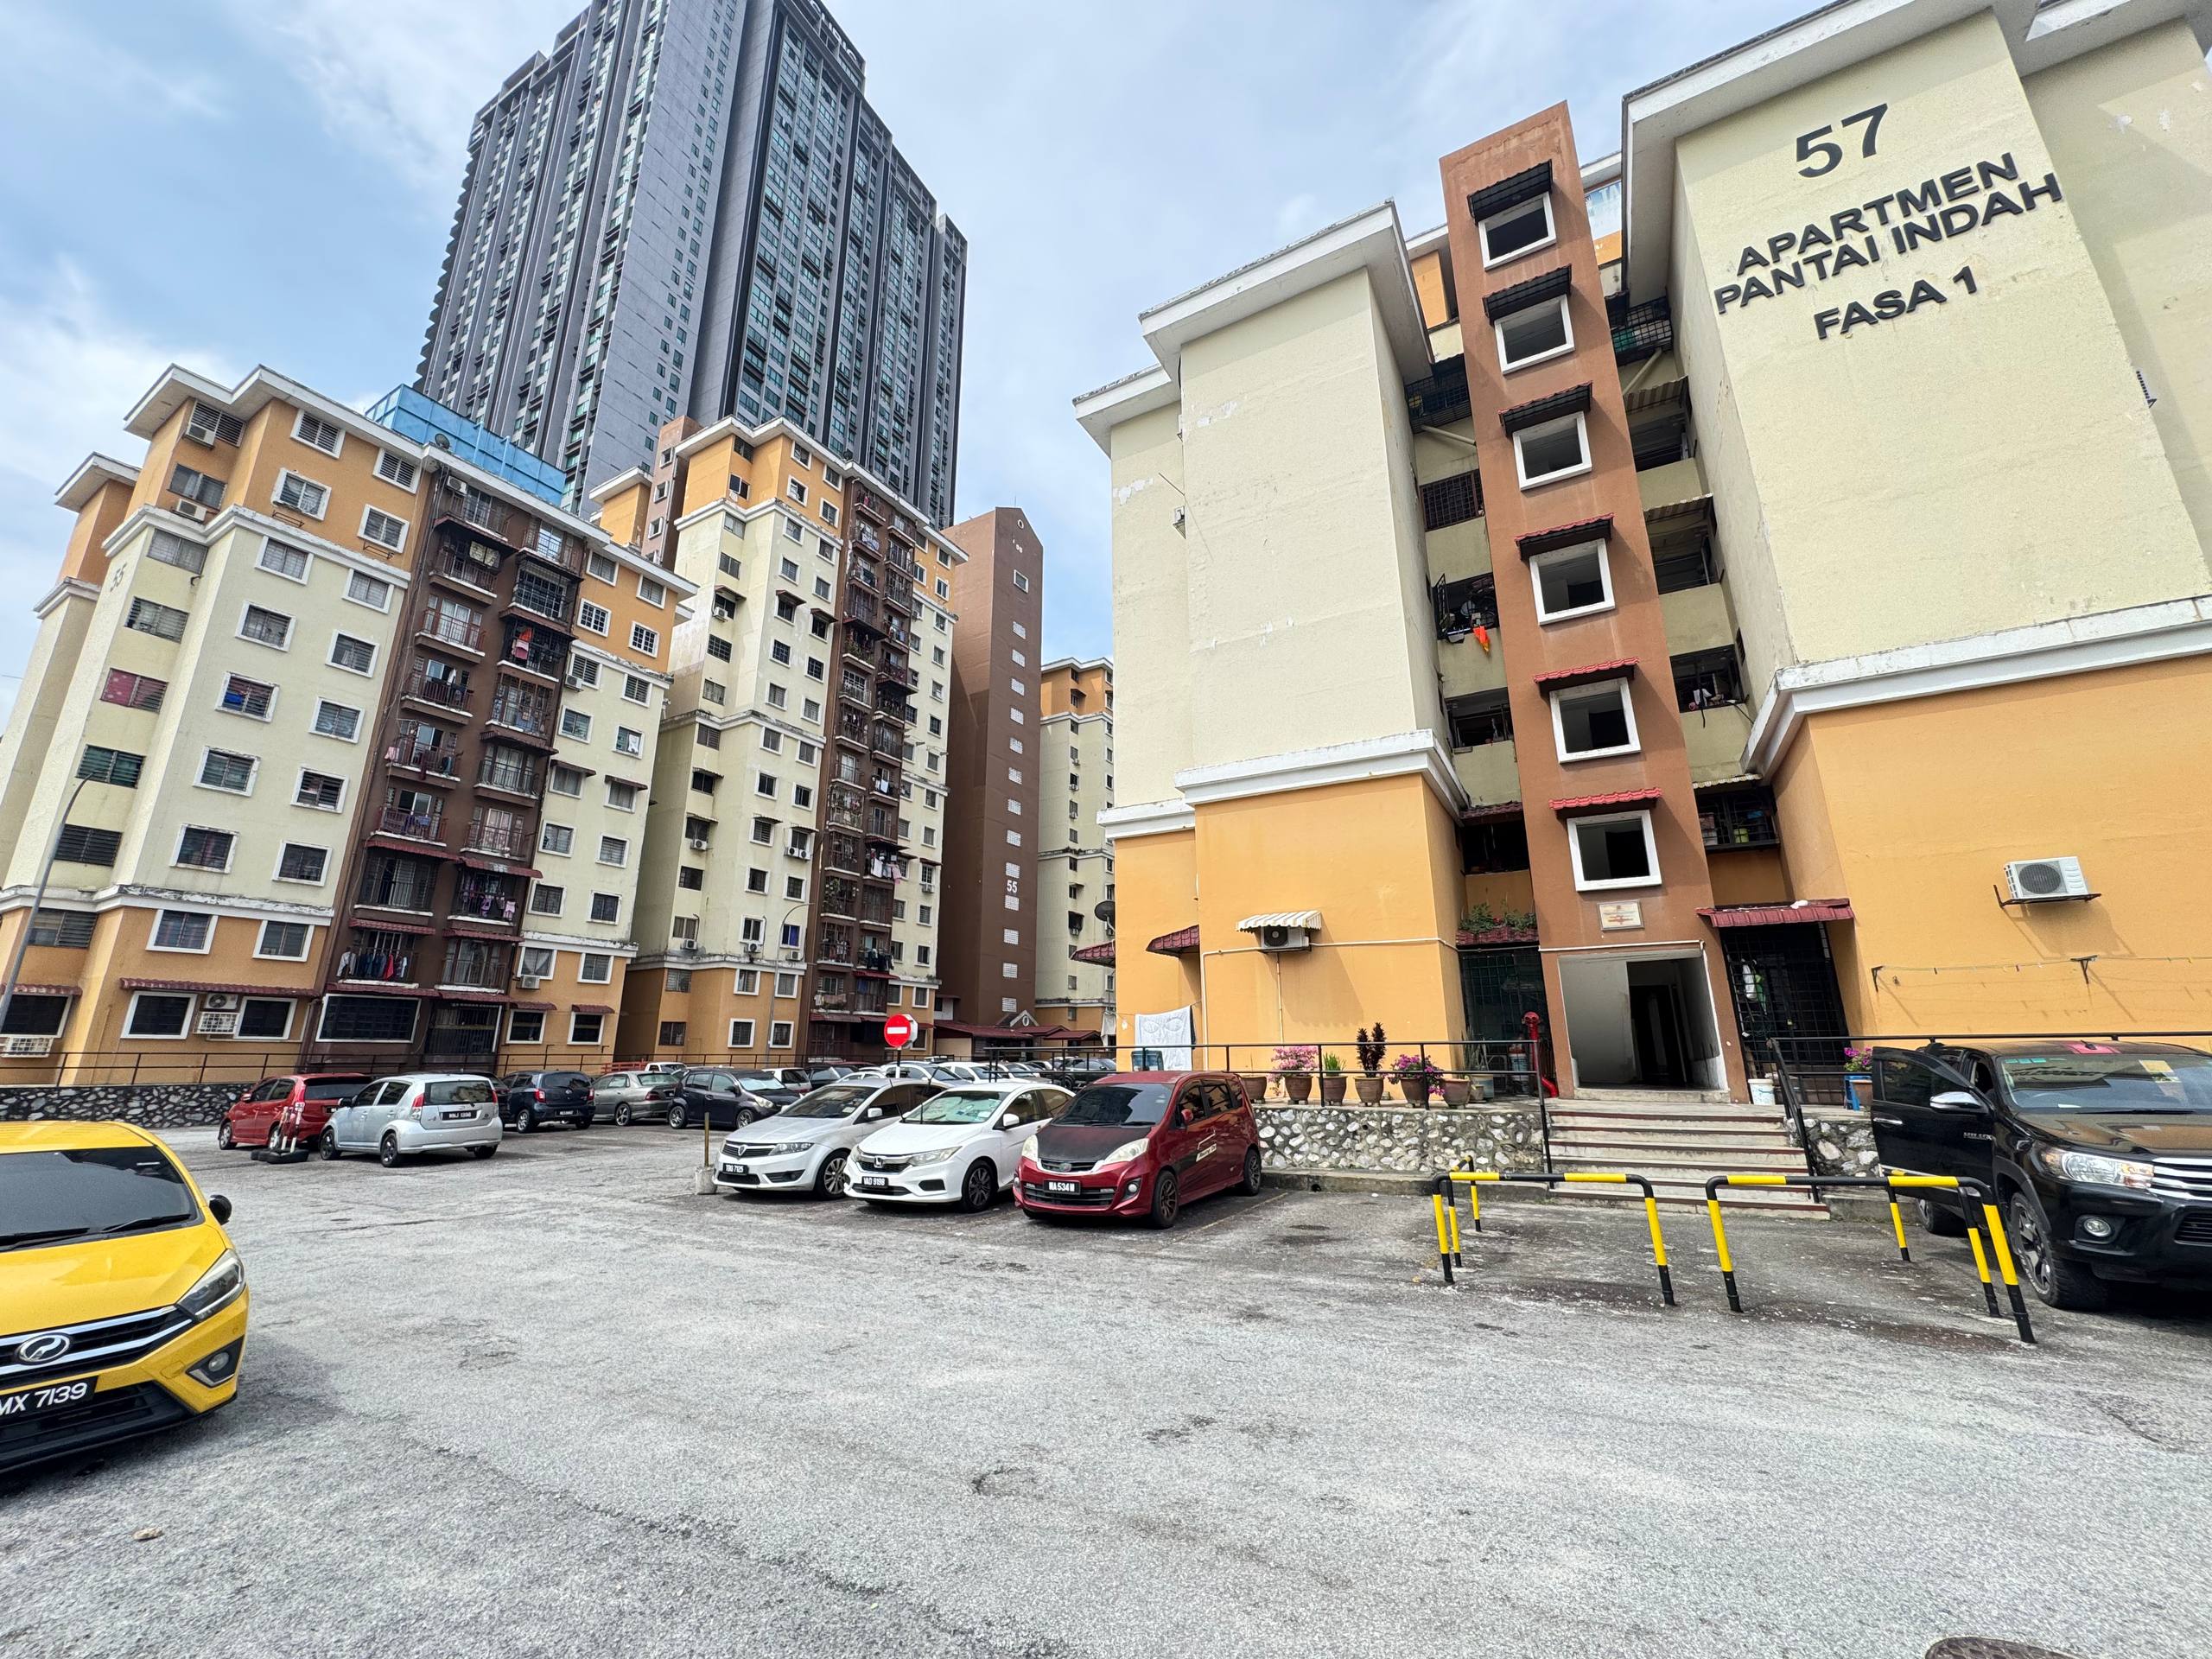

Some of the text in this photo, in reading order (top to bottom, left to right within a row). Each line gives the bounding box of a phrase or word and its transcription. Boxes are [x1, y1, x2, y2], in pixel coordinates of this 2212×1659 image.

[1796, 103, 1888, 178] 57
[1713, 173, 2063, 315] PANTAI INDAH
[1737, 152, 2019, 276] APARTMEN
[1814, 265, 1978, 340] FASA 1
[1006, 879, 1018, 893] 55
[35, 1382, 88, 1408] 7139
